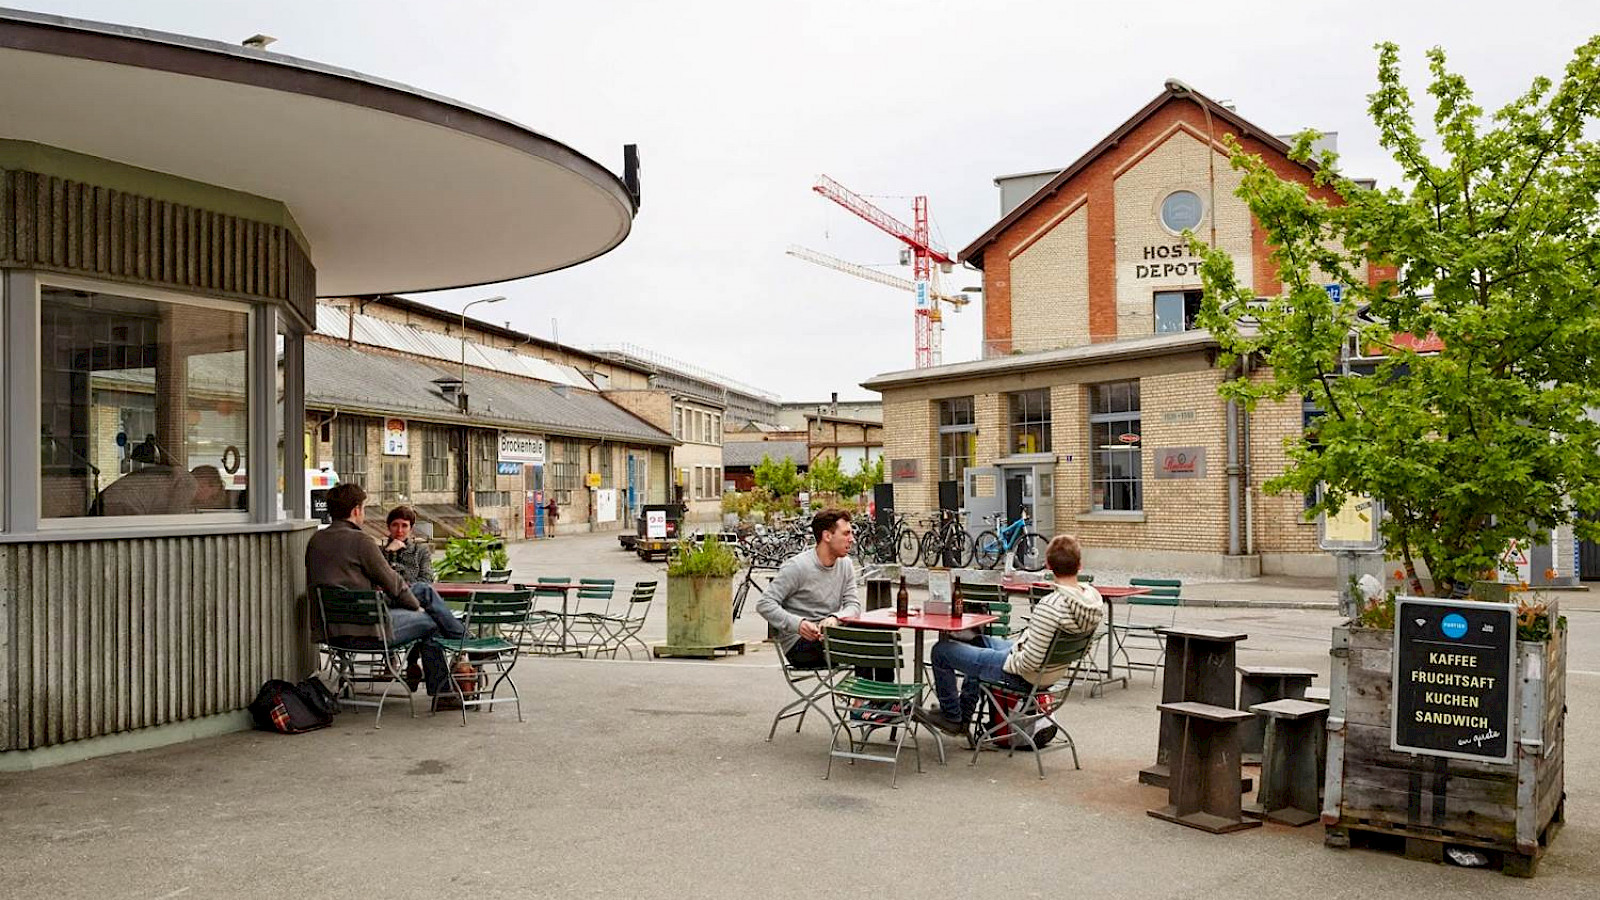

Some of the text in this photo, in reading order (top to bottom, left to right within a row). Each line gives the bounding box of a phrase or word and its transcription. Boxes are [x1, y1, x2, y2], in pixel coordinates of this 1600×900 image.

[1136, 262, 1205, 279] DEPOT
[1429, 652, 1478, 668] KAFFEE
[1411, 670, 1496, 690] FRUCHTSAFT
[1425, 691, 1480, 709] KUCHEN
[1415, 710, 1489, 729] SANDWICH
